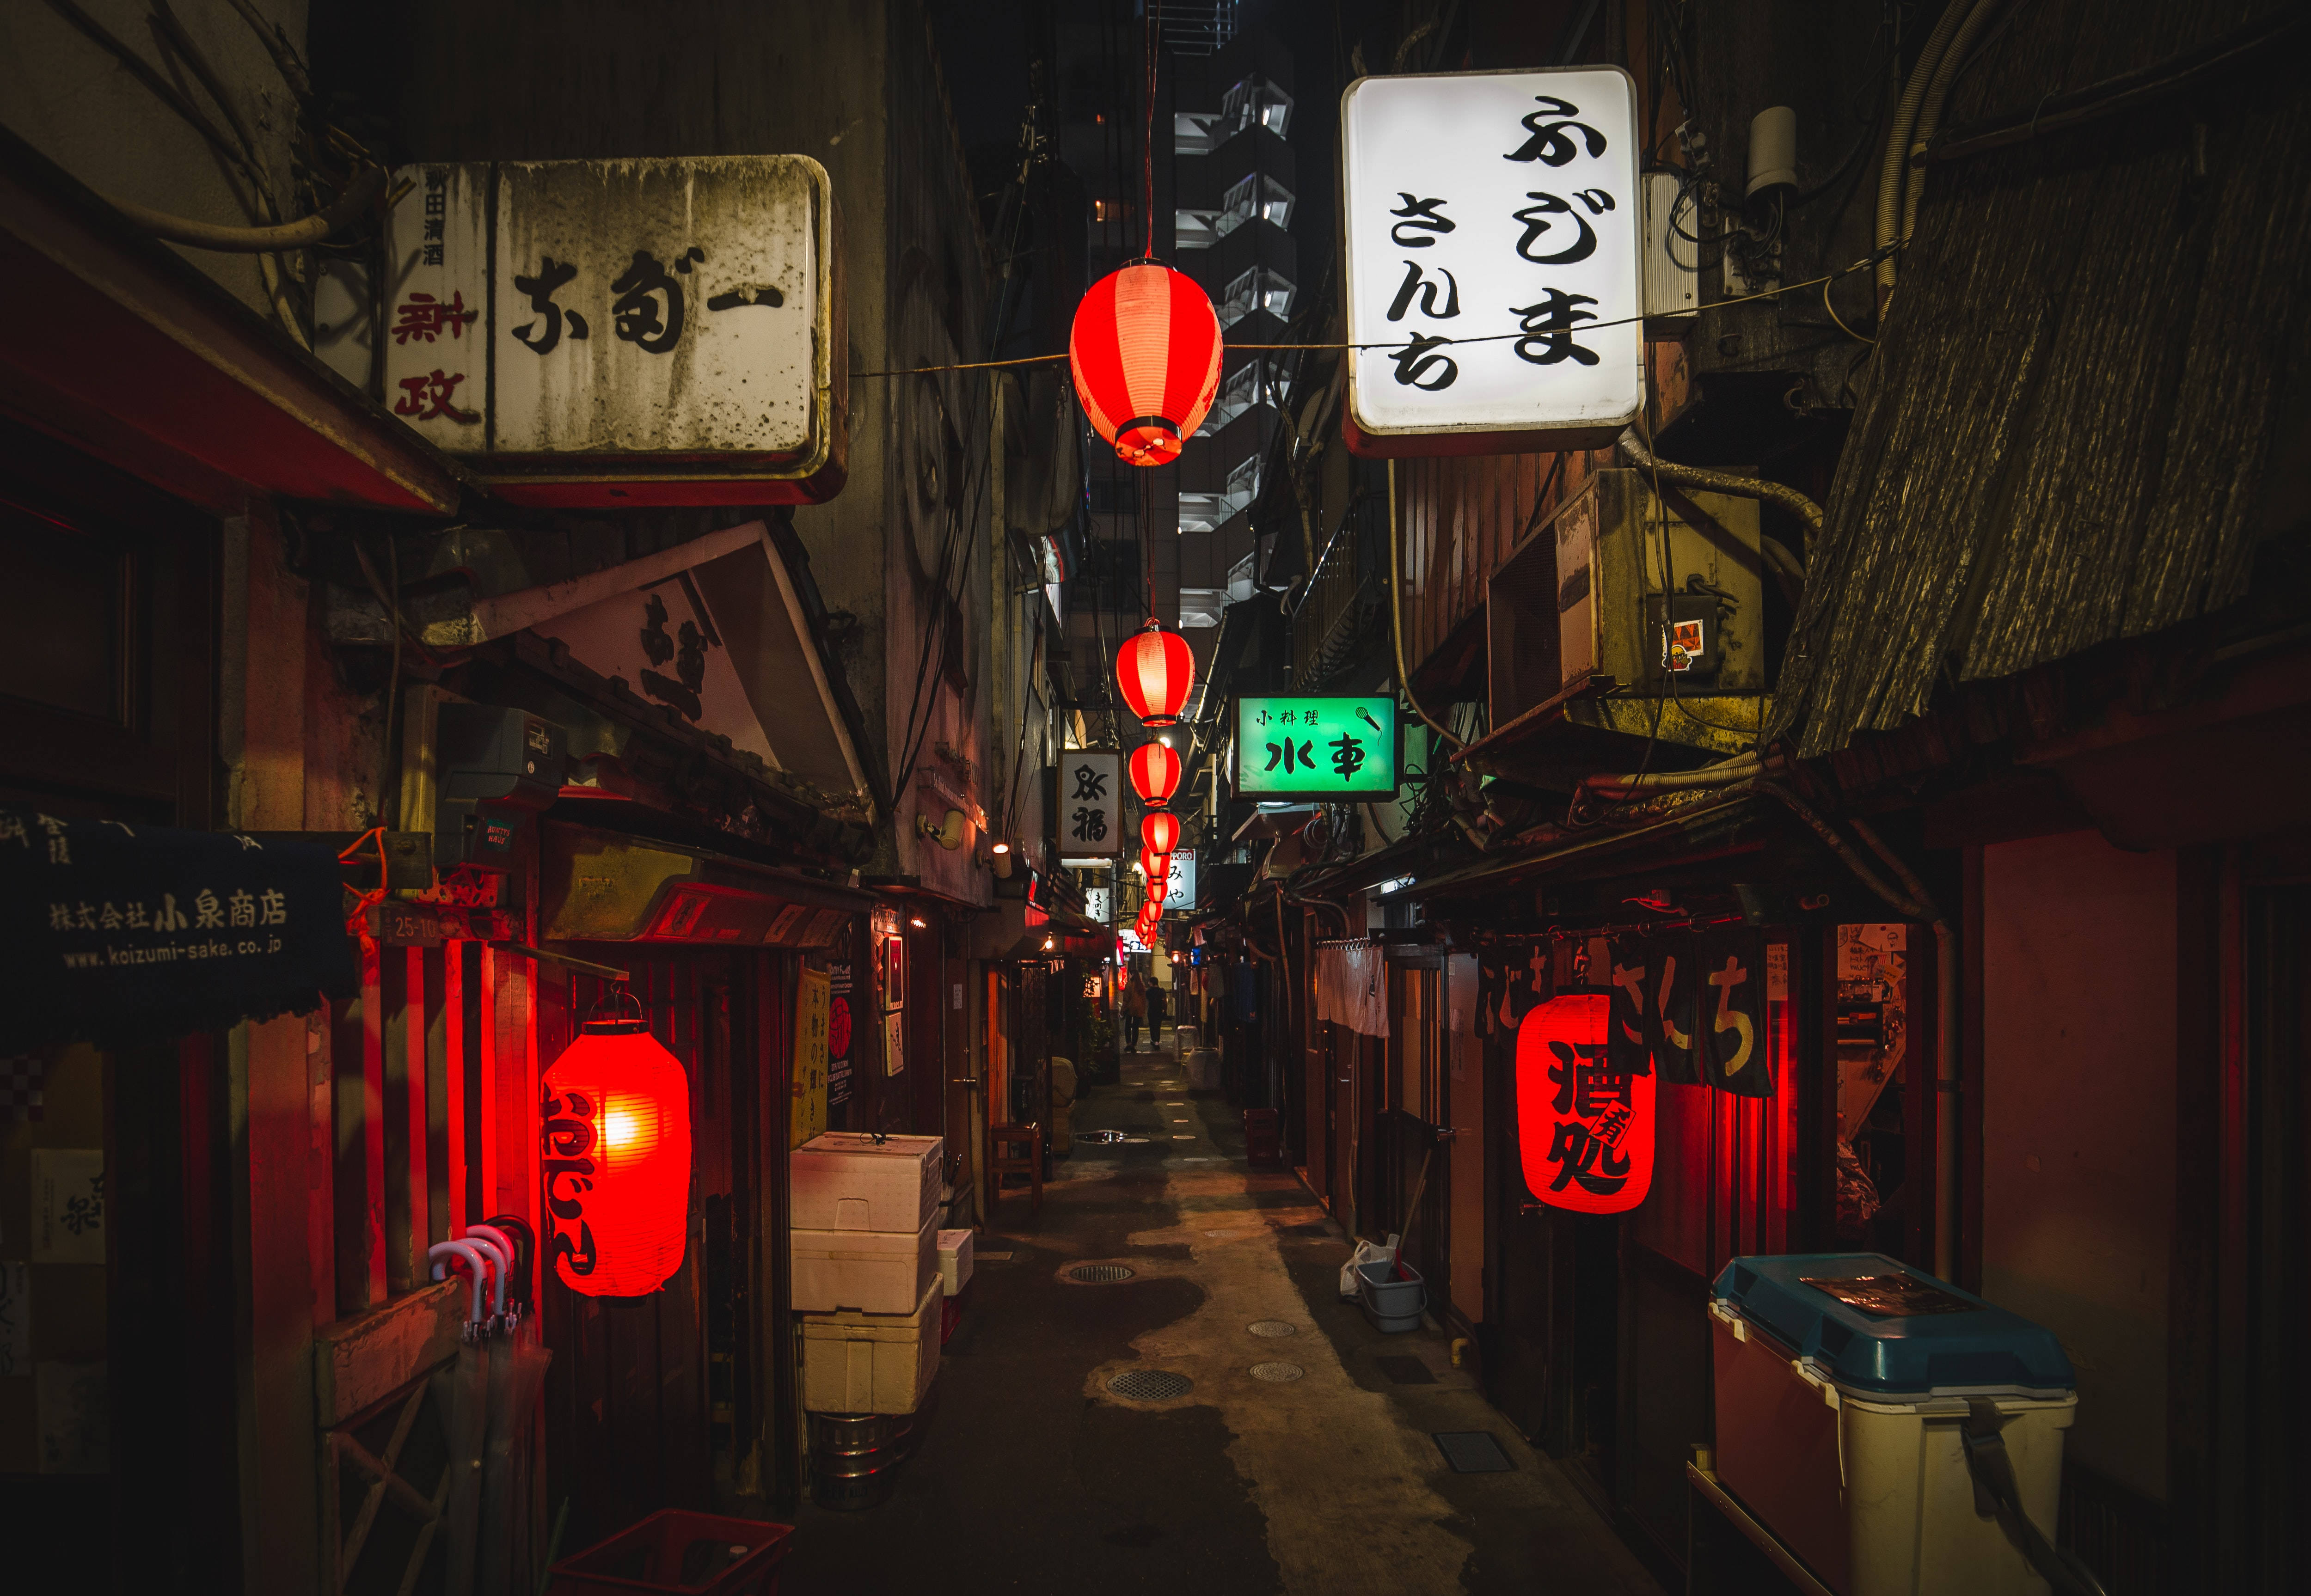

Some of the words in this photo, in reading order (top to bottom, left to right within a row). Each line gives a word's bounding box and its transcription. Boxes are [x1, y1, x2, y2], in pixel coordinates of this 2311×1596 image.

[423, 170, 447, 266] 秋田清酒
[1387, 192, 1461, 391] さんち
[392, 290, 482, 424] 新政
[1256, 709, 1319, 726] 小料理
[1264, 731, 1366, 782] 水車
[1171, 852, 1193, 860] PORO
[1167, 865, 1184, 904] みや
[49, 887, 287, 932] 株式会社小泉商店
[395, 917, 436, 938] 25-10
[63, 933, 282, 969] www.koizumi-sake.co.jp
[1548, 1041, 1633, 1195] 酒処
